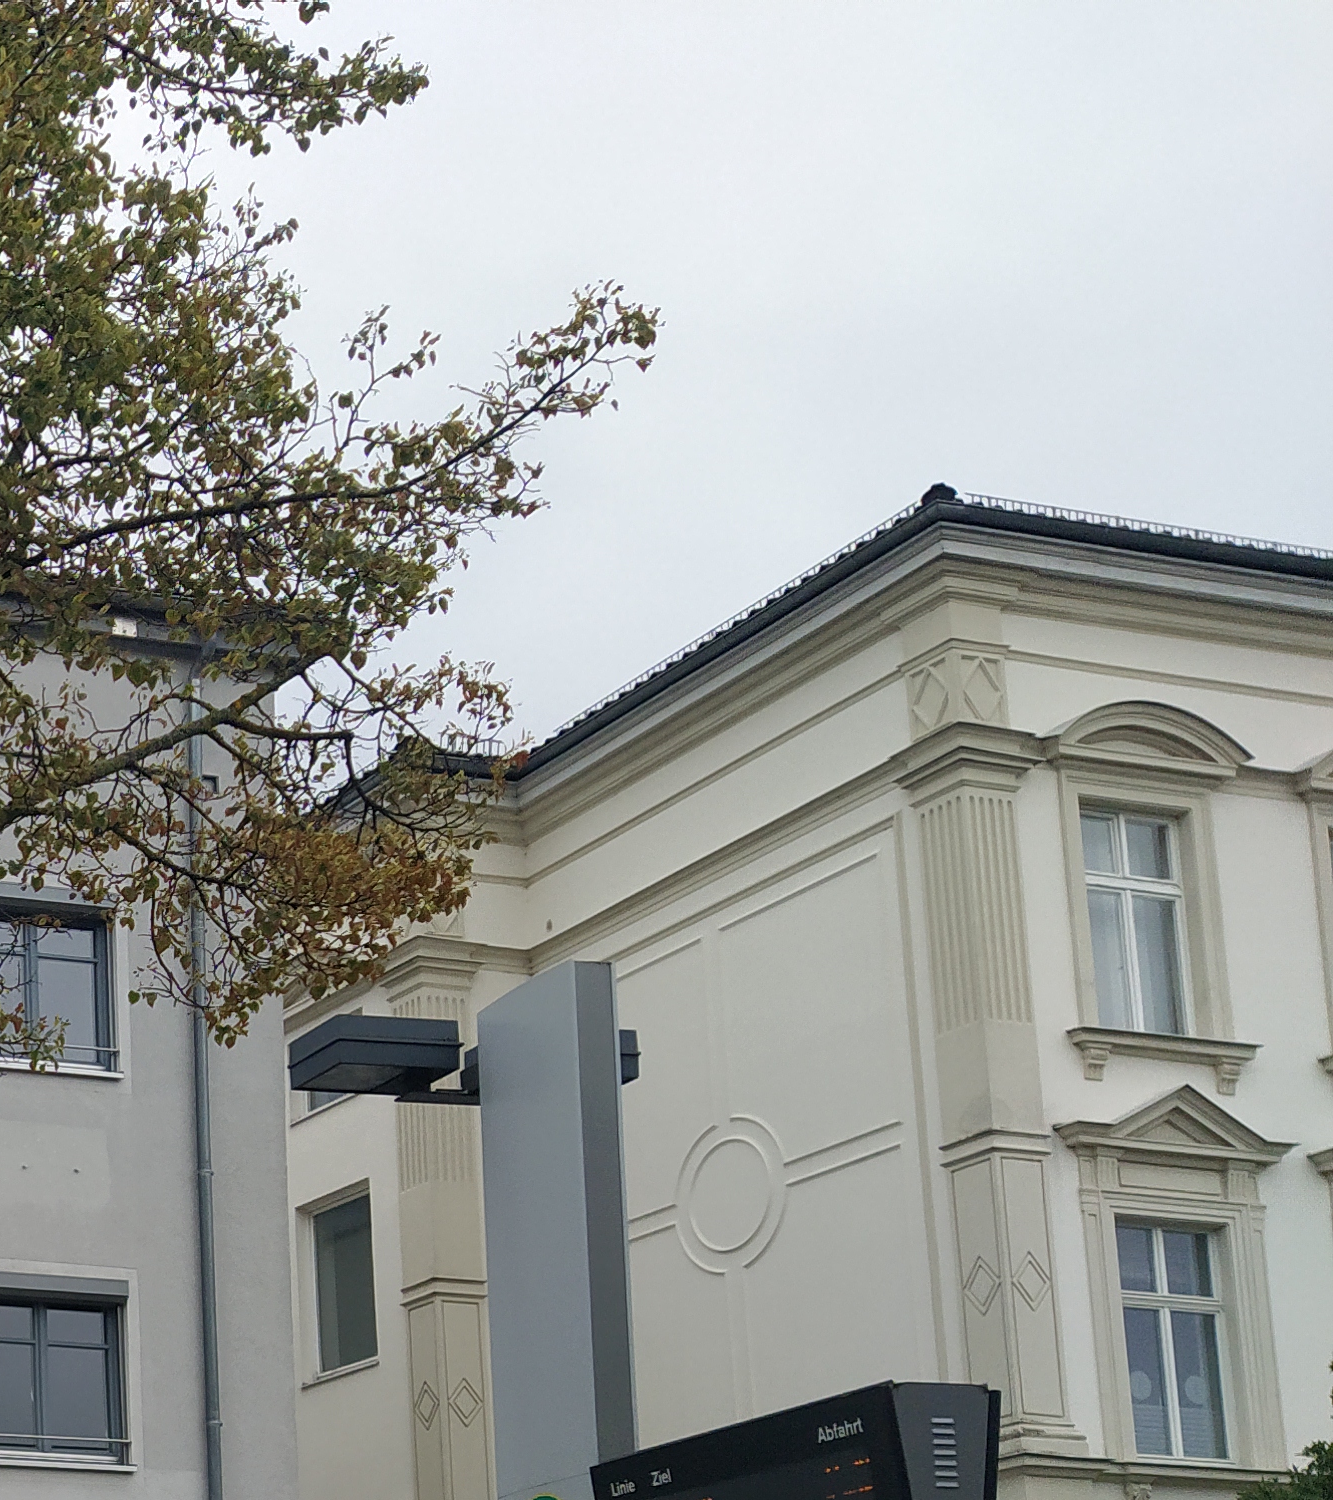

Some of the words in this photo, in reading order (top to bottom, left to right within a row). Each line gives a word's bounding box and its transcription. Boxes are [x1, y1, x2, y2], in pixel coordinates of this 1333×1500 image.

[817, 1417, 864, 1444] Abfahrt
[610, 1479, 636, 1497] Linie
[650, 1468, 672, 1486] Ziel
